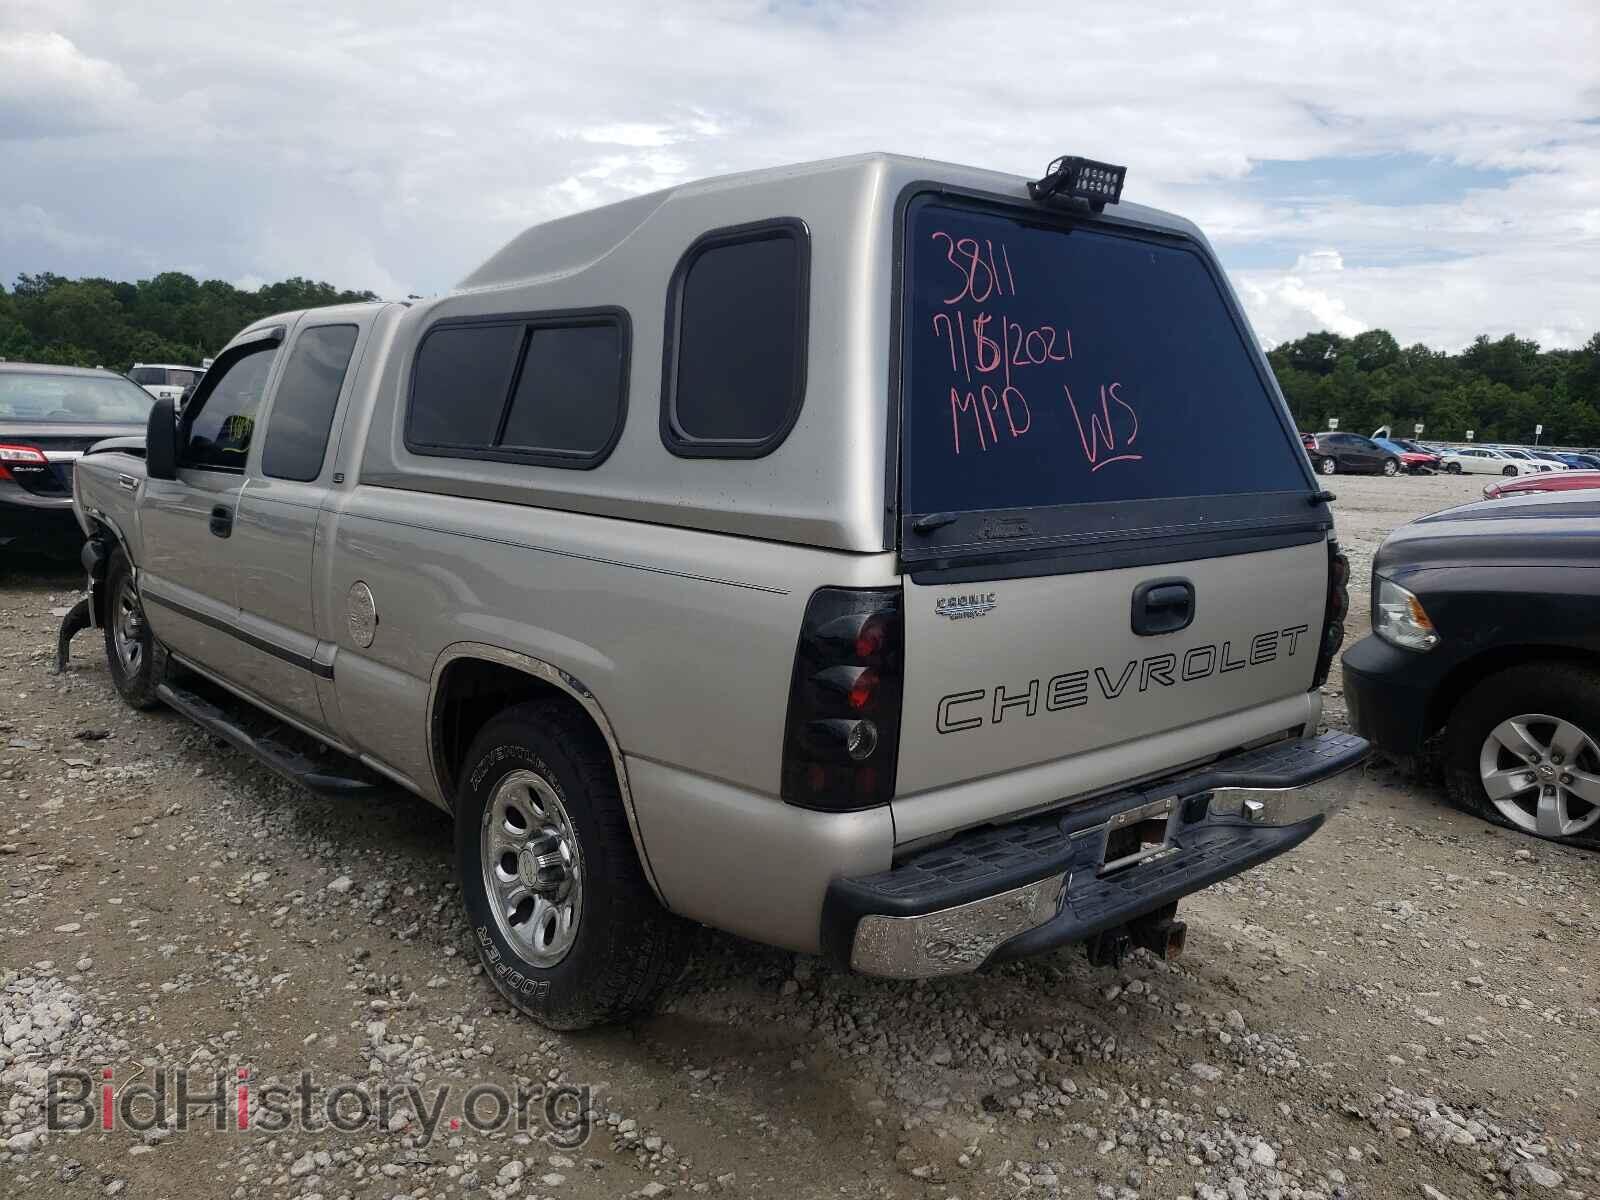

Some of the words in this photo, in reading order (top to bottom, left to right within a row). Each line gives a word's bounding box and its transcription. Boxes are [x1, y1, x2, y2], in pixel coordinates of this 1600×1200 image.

[932, 232, 1016, 304] 3811
[950, 384, 1031, 454] MPD
[935, 624, 1309, 735] CHEVROLET
[476, 925, 551, 999] COOPER
